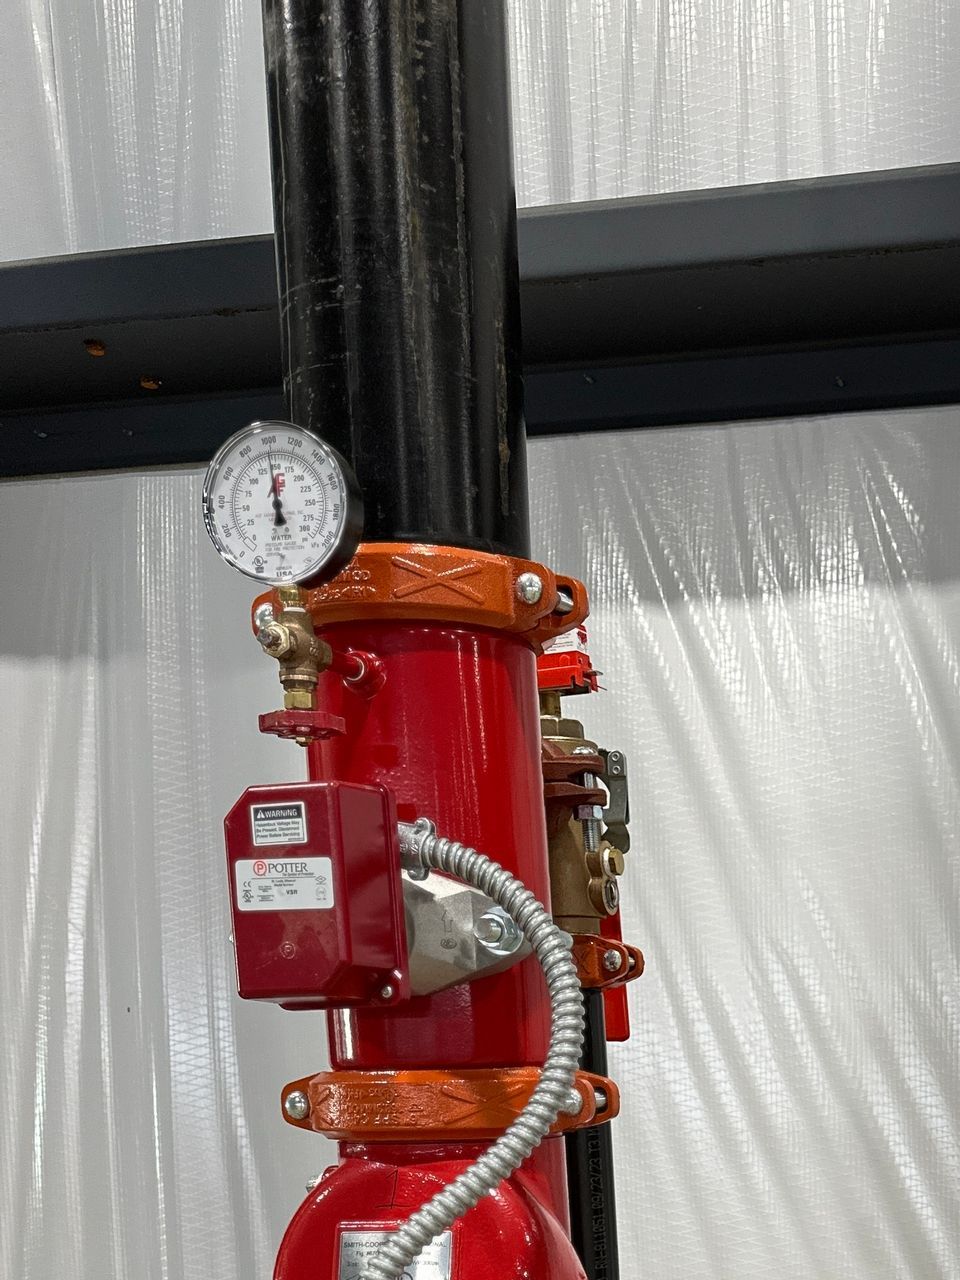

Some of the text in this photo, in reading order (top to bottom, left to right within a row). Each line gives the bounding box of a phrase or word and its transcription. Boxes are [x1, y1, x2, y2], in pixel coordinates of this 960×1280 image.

[261, 436, 276, 445] 1000
[288, 436, 302, 448] 1200
[239, 445, 252, 458] 800
[312, 449, 326, 466] 1400
[223, 466, 234, 481] 600
[285, 465, 294, 473] 175
[294, 474, 304, 482] 200
[328, 472, 338, 490] 1600
[245, 490, 252, 498] 75
[218, 495, 226, 510] 400
[332, 504, 340, 521] 1800
[222, 524, 232, 538] 200
[311, 541, 319, 549] kPa
[322, 531, 336, 548] 2000
[265, 809, 298, 818] WARNING
[268, 862, 308, 873] POTTER
